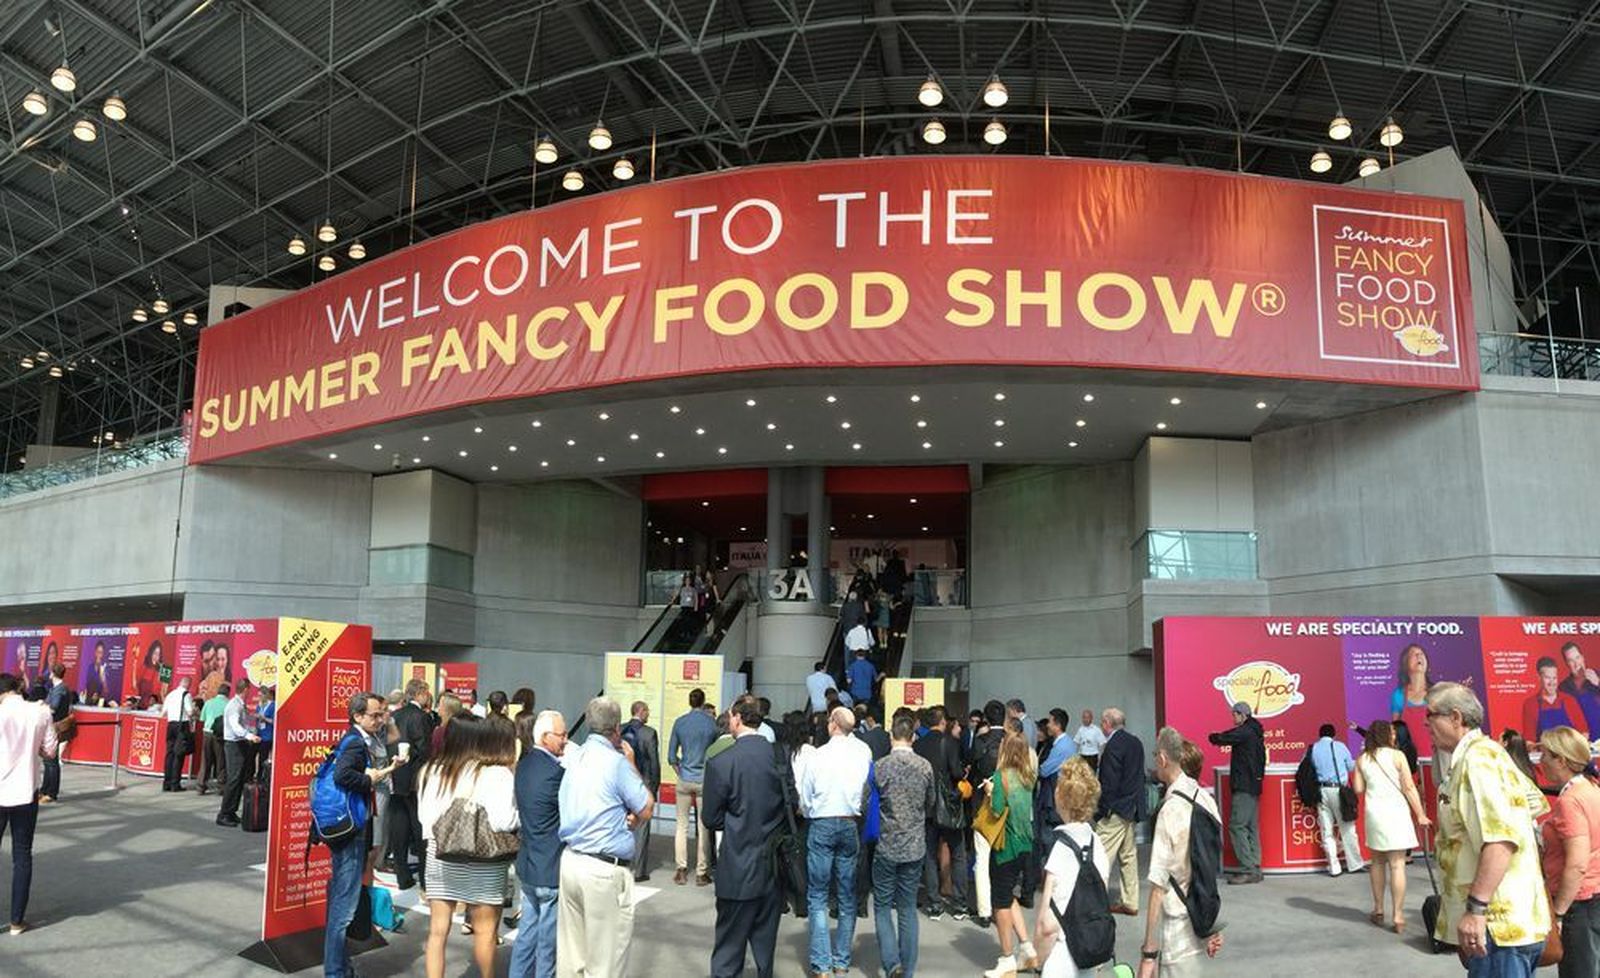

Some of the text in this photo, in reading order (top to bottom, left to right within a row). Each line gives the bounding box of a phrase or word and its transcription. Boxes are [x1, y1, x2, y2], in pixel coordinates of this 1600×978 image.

[1334, 225, 1433, 248] Summer
[325, 189, 993, 344] WELCOME TO THE
[1334, 245, 1433, 276] FANCY
[1336, 272, 1436, 305] FOOD
[1337, 301, 1437, 330] SHOW
[199, 351, 382, 438] SUMMER
[401, 295, 626, 387] FANCY
[654, 271, 909, 343] FOOD
[768, 568, 815, 600] 3A
[165, 626, 175, 634] WE
[177, 625, 190, 634] ARE
[191, 625, 230, 634] SPECIALTY
[281, 623, 309, 656] EARLY
[1266, 622, 1464, 635] WE ARE SPECIALTY FOOD.
[1522, 622, 1547, 634] WE
[1549, 622, 1578, 634] ARE
[284, 628, 321, 674] OPENING
[289, 637, 329, 688] at 9:30 am
[332, 674, 361, 686] FANCY
[1254, 670, 1297, 715] food
[287, 729, 329, 743] NORTH
[1275, 729, 1285, 737] at
